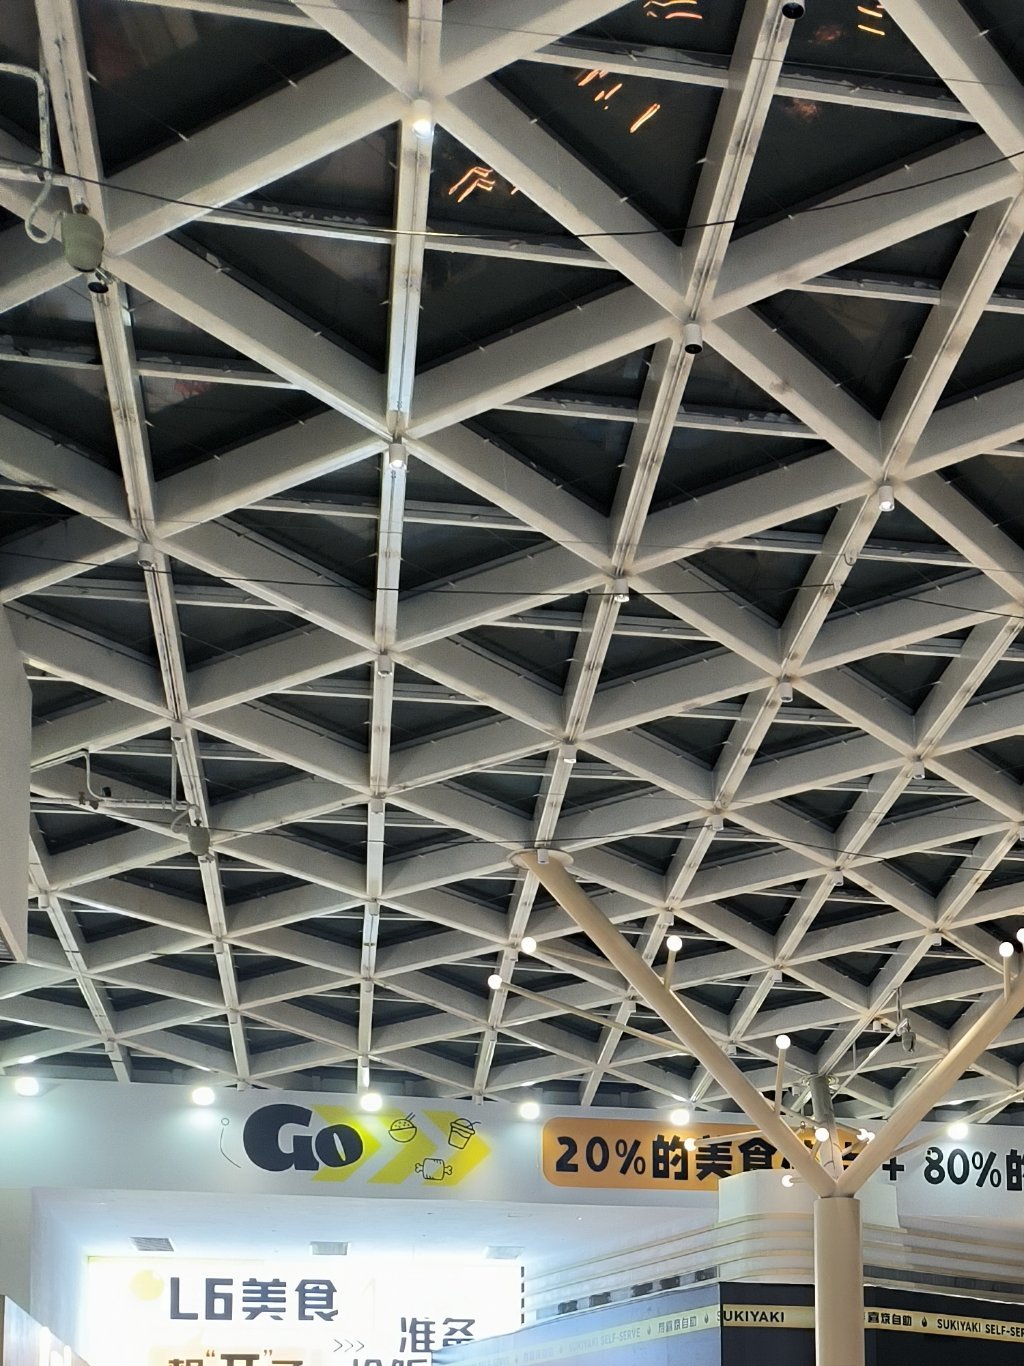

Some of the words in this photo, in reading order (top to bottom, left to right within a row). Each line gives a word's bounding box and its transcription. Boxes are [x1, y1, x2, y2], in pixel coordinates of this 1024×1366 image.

[170, 1276, 339, 1322] L6美食
[399, 1316, 476, 1353] 准备
[864, 1312, 912, 1327] 喜烧自助
[936, 1317, 981, 1334] SUKIYAKI
